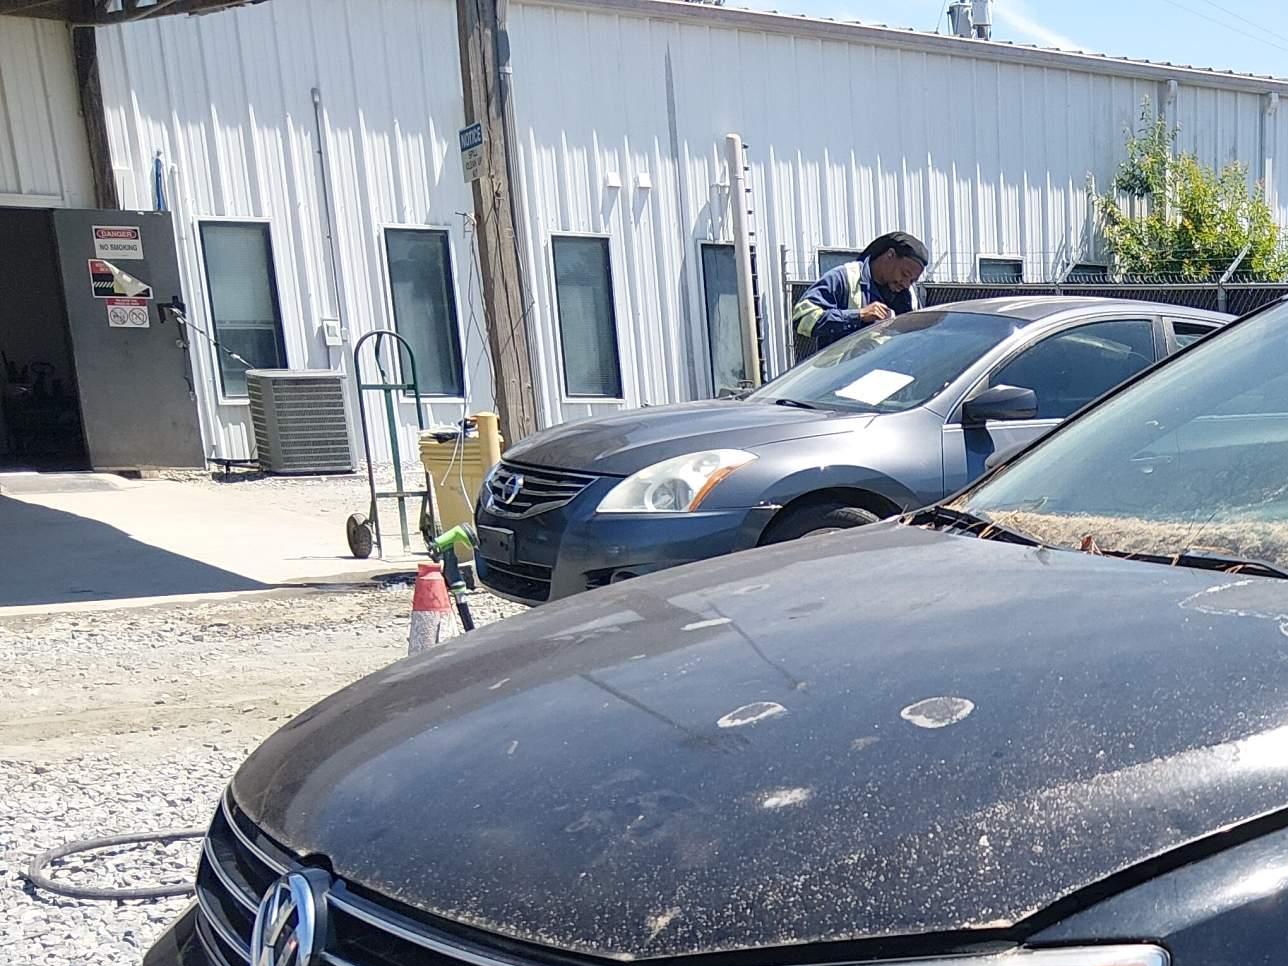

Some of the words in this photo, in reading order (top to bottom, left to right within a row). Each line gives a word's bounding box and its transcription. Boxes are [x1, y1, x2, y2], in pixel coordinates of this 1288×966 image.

[460, 127, 481, 148] NOTICE
[100, 230, 133, 238] DANGER
[110, 244, 137, 252] SMOKING
